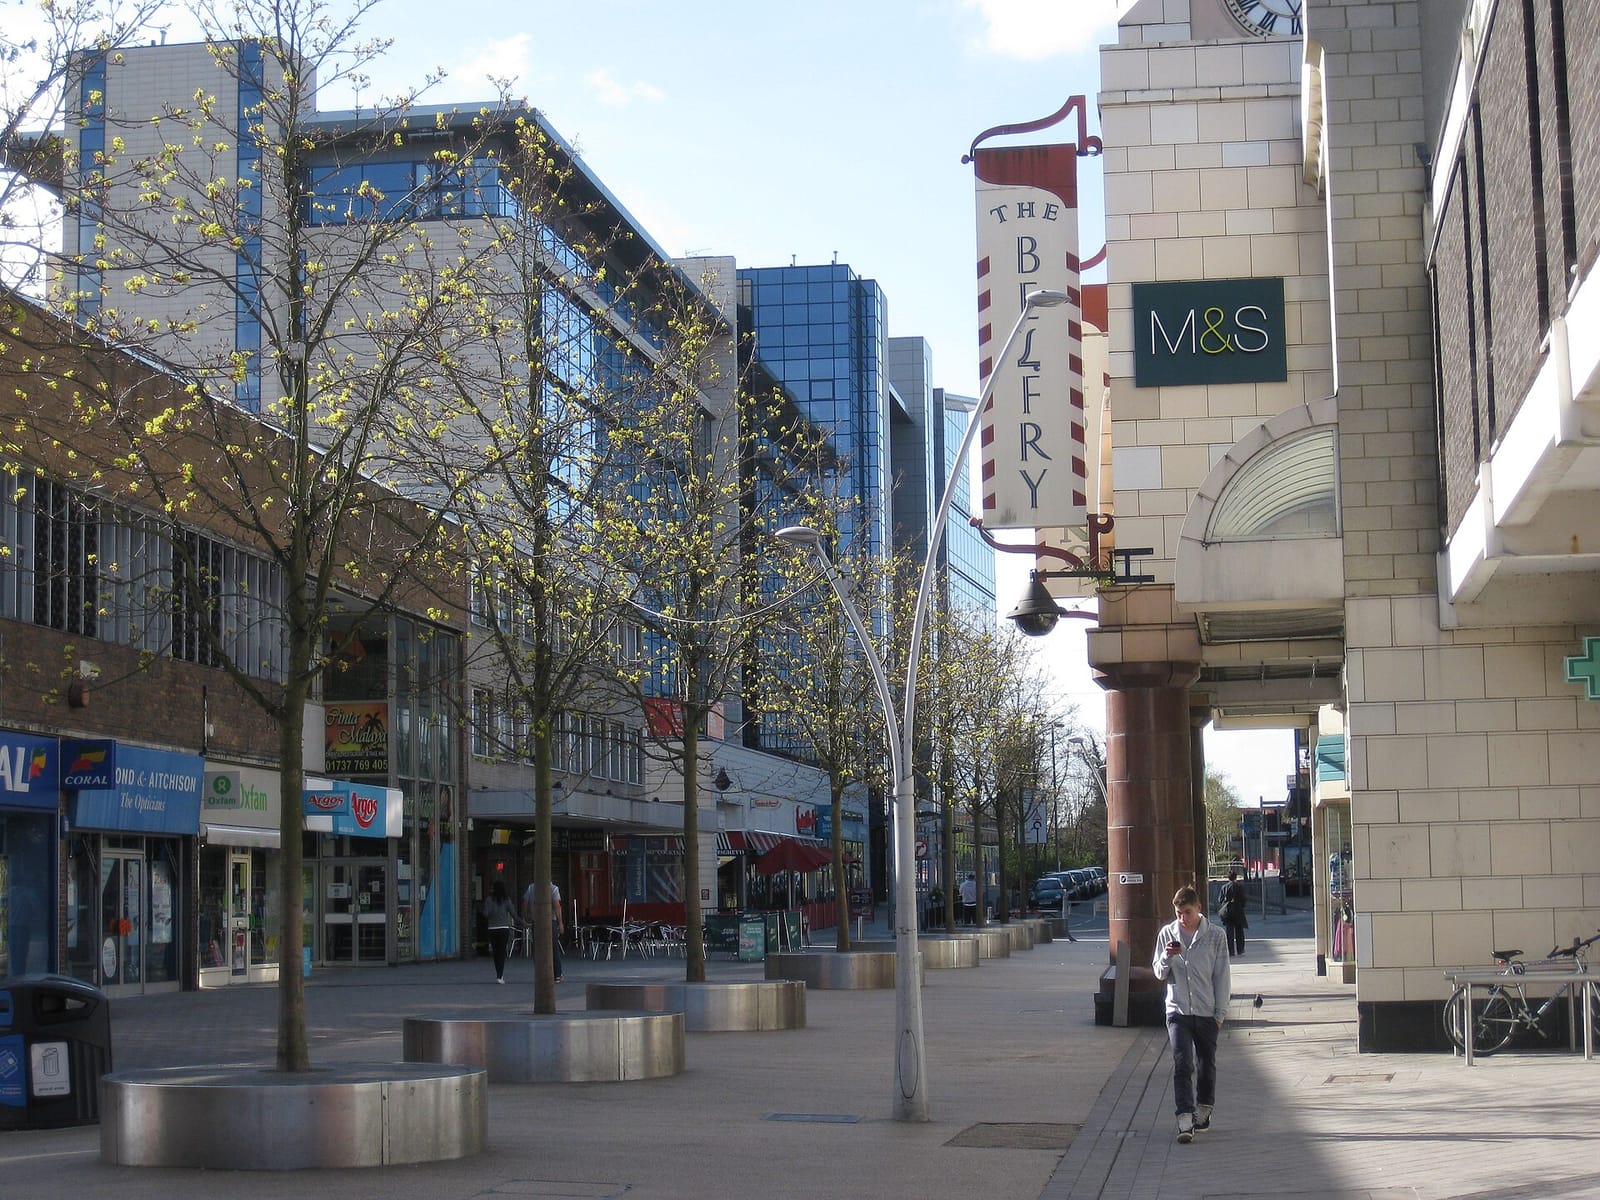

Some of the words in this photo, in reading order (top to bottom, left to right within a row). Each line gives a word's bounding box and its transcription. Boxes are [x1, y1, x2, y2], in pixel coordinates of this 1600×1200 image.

[990, 201, 1059, 224] THE
[1151, 305, 1269, 354] M&S
[1015, 235, 1053, 510] BELFRY
[326, 760, 352, 771] 01737
[354, 760, 370, 770] 769
[372, 760, 388, 770] 405
[64, 775, 108, 785] CORAL
[148, 772, 197, 792] AITCHISON
[120, 792, 133, 809] The
[134, 793, 166, 814] Opticians
[208, 796, 236, 805] Oxfam
[308, 793, 345, 810] Argos
[351, 790, 378, 826] Argos
